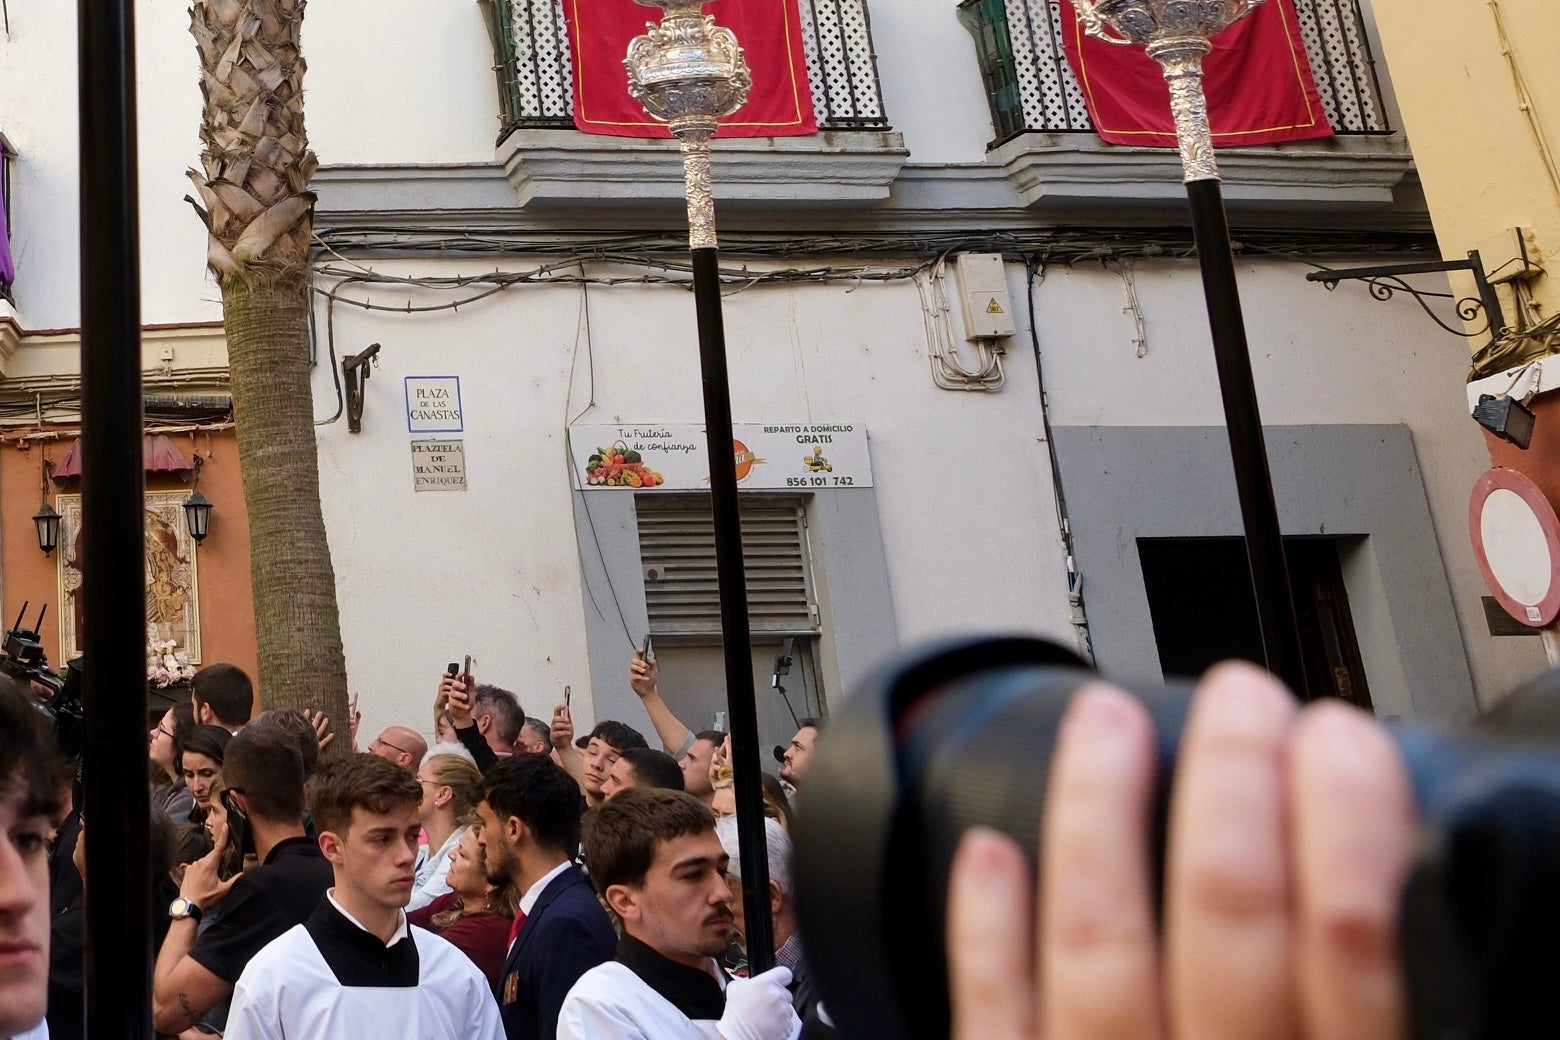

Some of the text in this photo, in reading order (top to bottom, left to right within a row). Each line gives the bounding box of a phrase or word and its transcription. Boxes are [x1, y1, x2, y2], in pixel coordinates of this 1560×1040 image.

[416, 388, 449, 399] PLAZA
[410, 409, 460, 420] CANASTAS
[618, 428, 672, 438] Tu Frutería
[803, 425, 809, 433] A
[810, 425, 853, 433] DOMICILIO
[796, 434, 833, 444] GRATIS
[412, 444, 463, 453] PLAZUELA
[633, 441, 697, 454] de confianza
[430, 455, 446, 463] DE
[414, 465, 461, 473] MANUEL
[415, 476, 466, 486] ENRIQUEZ
[786, 476, 854, 486] 856 101 742
